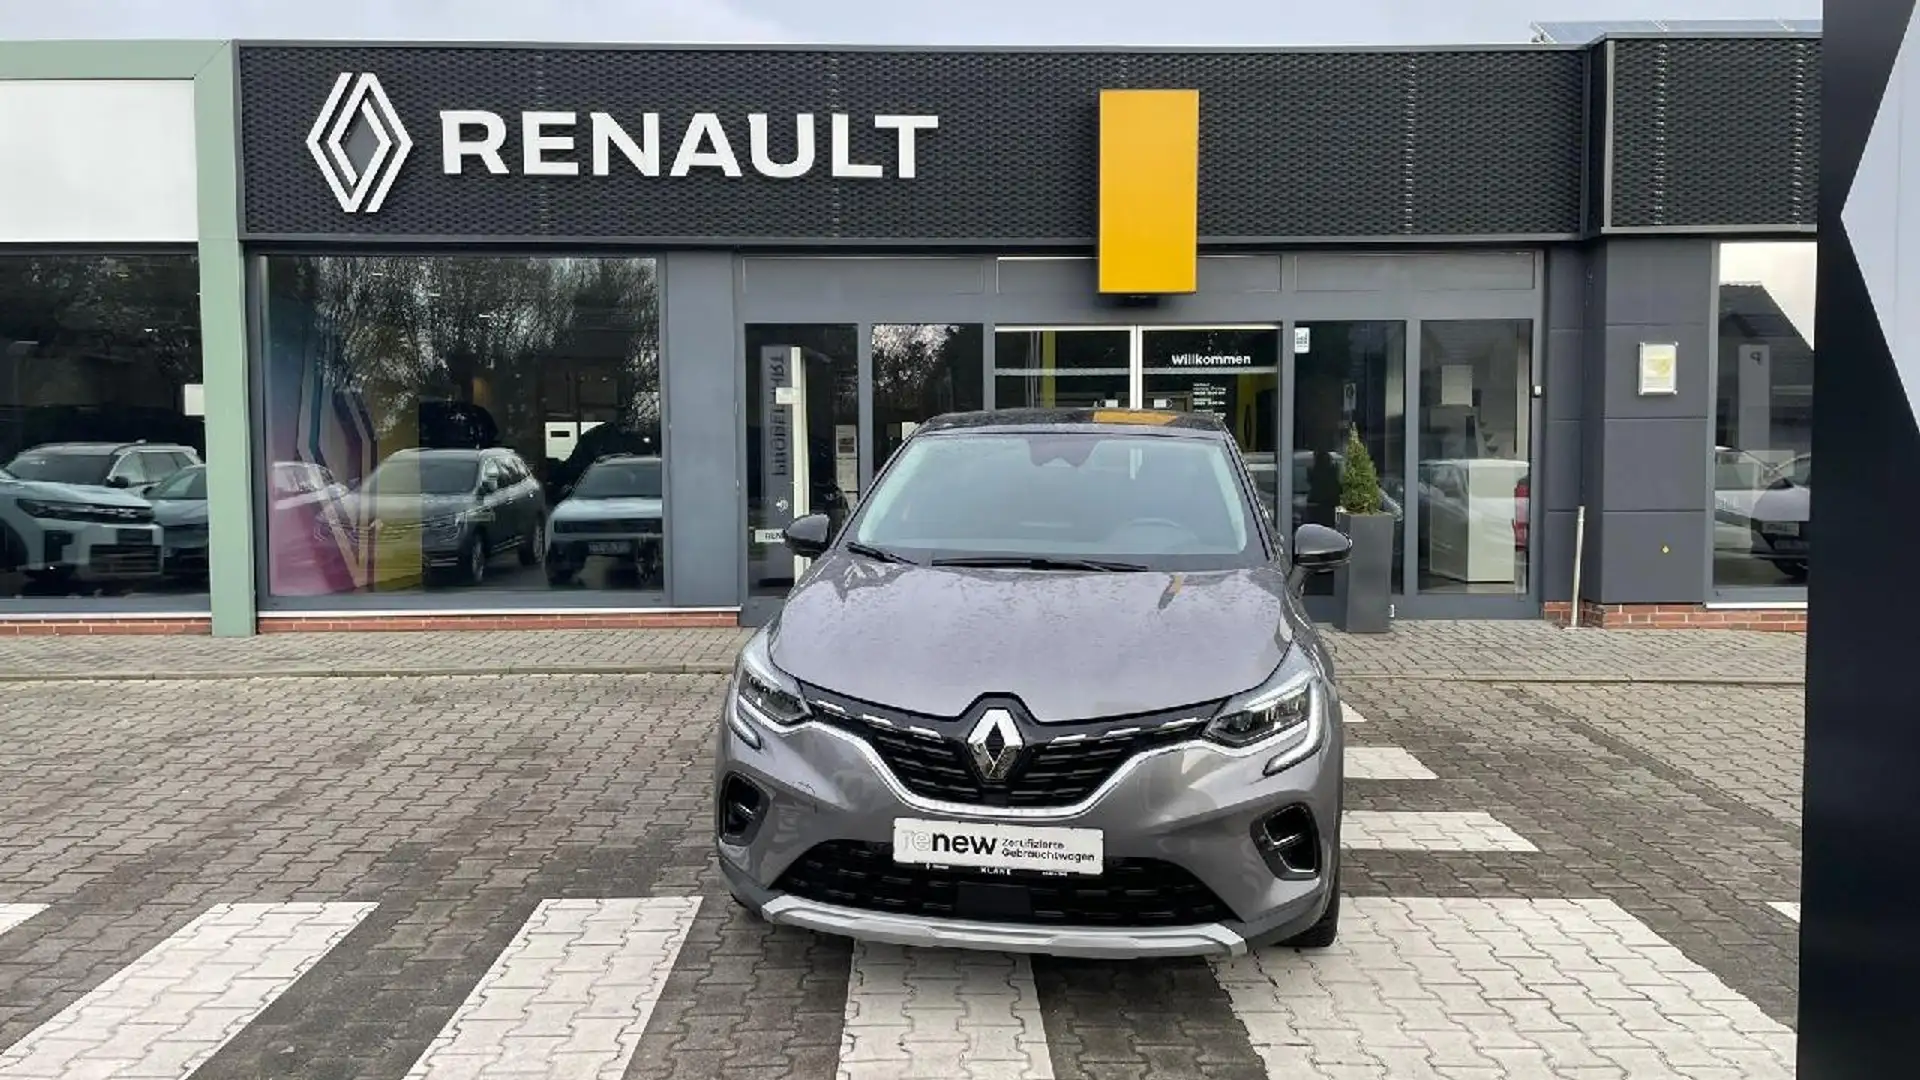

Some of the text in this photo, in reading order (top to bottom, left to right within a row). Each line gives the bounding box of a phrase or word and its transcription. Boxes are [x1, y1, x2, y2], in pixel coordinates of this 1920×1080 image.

[439, 110, 939, 179] RENAULT
[1171, 353, 1252, 365] Willkommen
[901, 830, 998, 855] renew
[1002, 838, 1065, 850] Zertifizierte
[1002, 847, 1095, 864] Gebrauchtwagen
